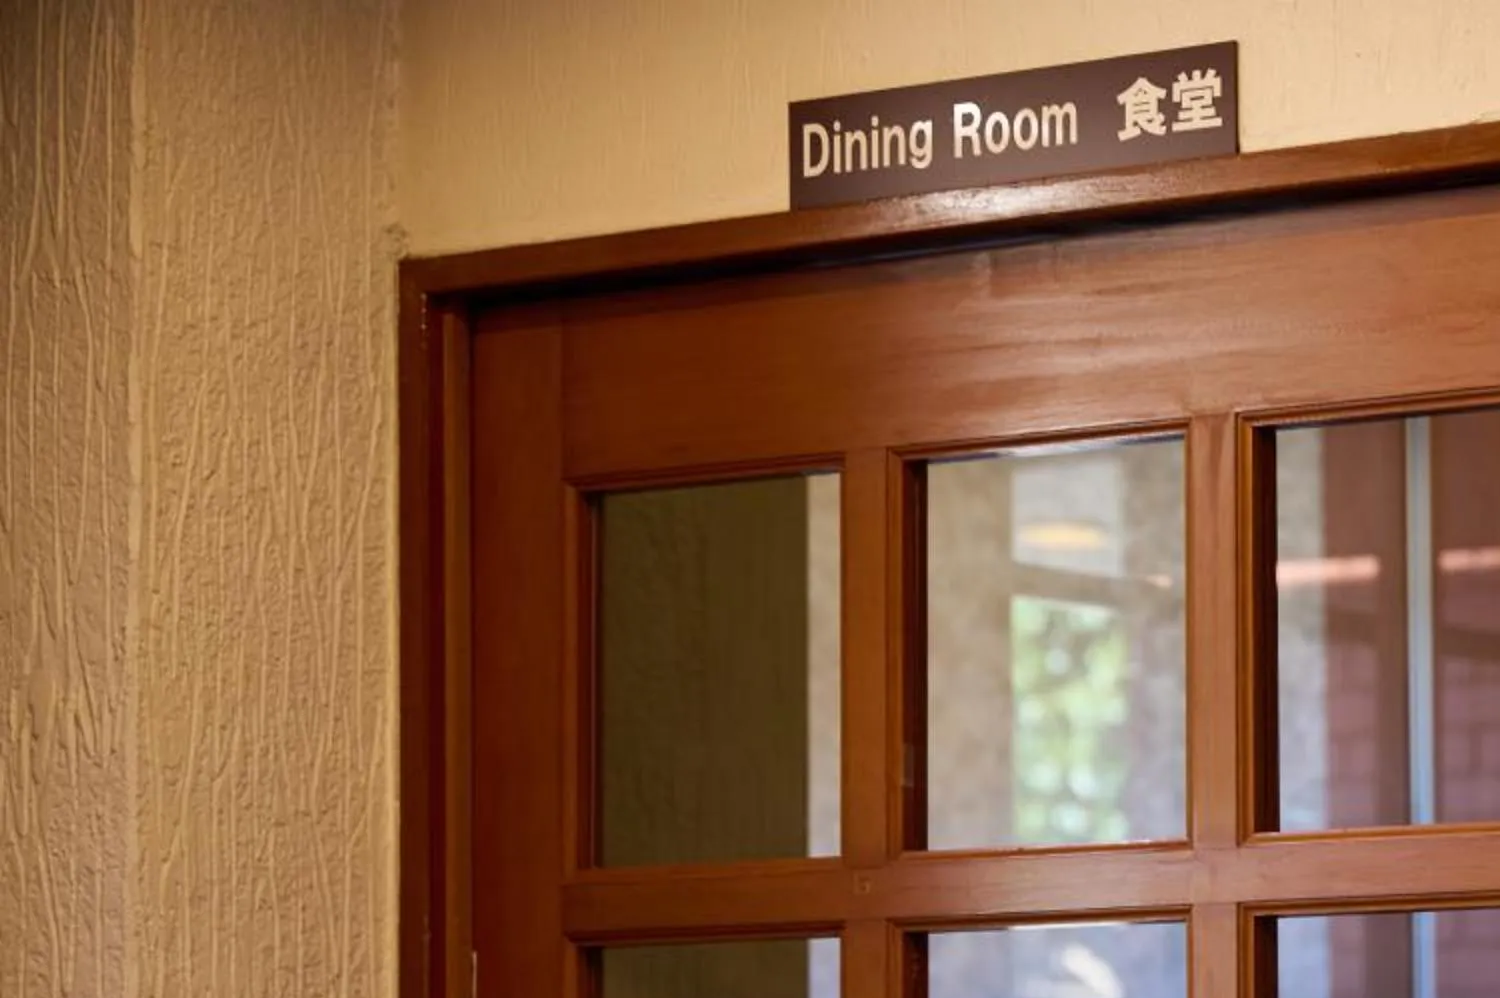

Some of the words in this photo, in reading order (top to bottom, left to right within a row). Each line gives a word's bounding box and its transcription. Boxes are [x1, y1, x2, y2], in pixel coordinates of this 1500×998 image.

[802, 115, 934, 178] Dining
[952, 101, 1078, 159] Room
[1116, 68, 1224, 143] 食堂
